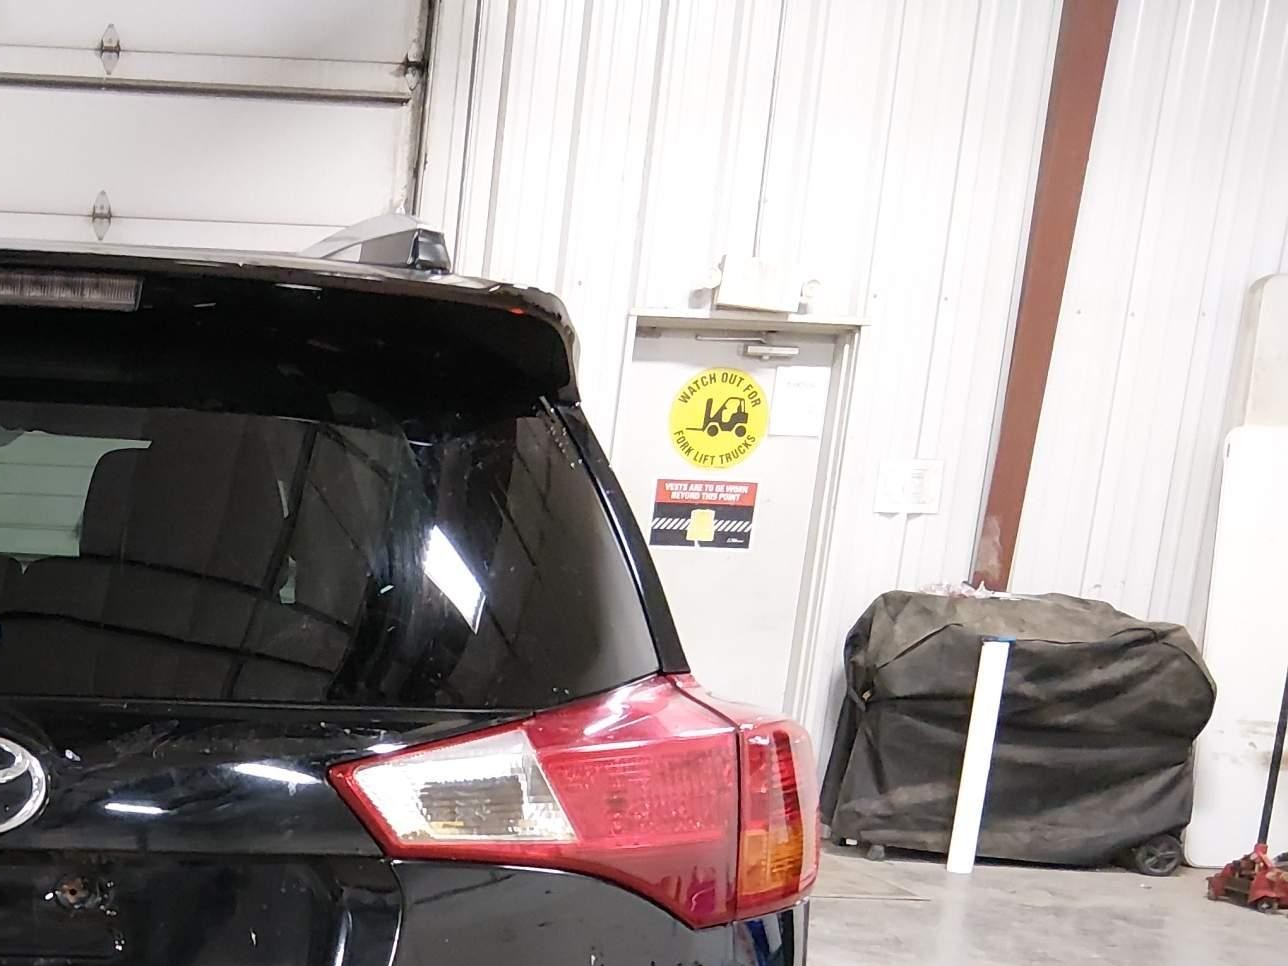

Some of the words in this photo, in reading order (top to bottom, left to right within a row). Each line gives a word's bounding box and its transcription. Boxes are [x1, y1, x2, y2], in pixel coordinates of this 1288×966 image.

[678, 372, 717, 404] WATCH
[721, 372, 745, 387] OUT
[743, 384, 761, 408] FOR
[673, 430, 695, 456] FORK
[693, 451, 716, 465] LIFT
[719, 435, 756, 464] TRUCKS
[664, 483, 688, 491] VESTS
[688, 484, 703, 492] ARE
[705, 484, 714, 492] TO
[715, 485, 726, 493] BE
[726, 485, 749, 494] WORN
[670, 491, 701, 500] BEYOND
[701, 492, 717, 501] THIS
[718, 493, 741, 502] POINT
